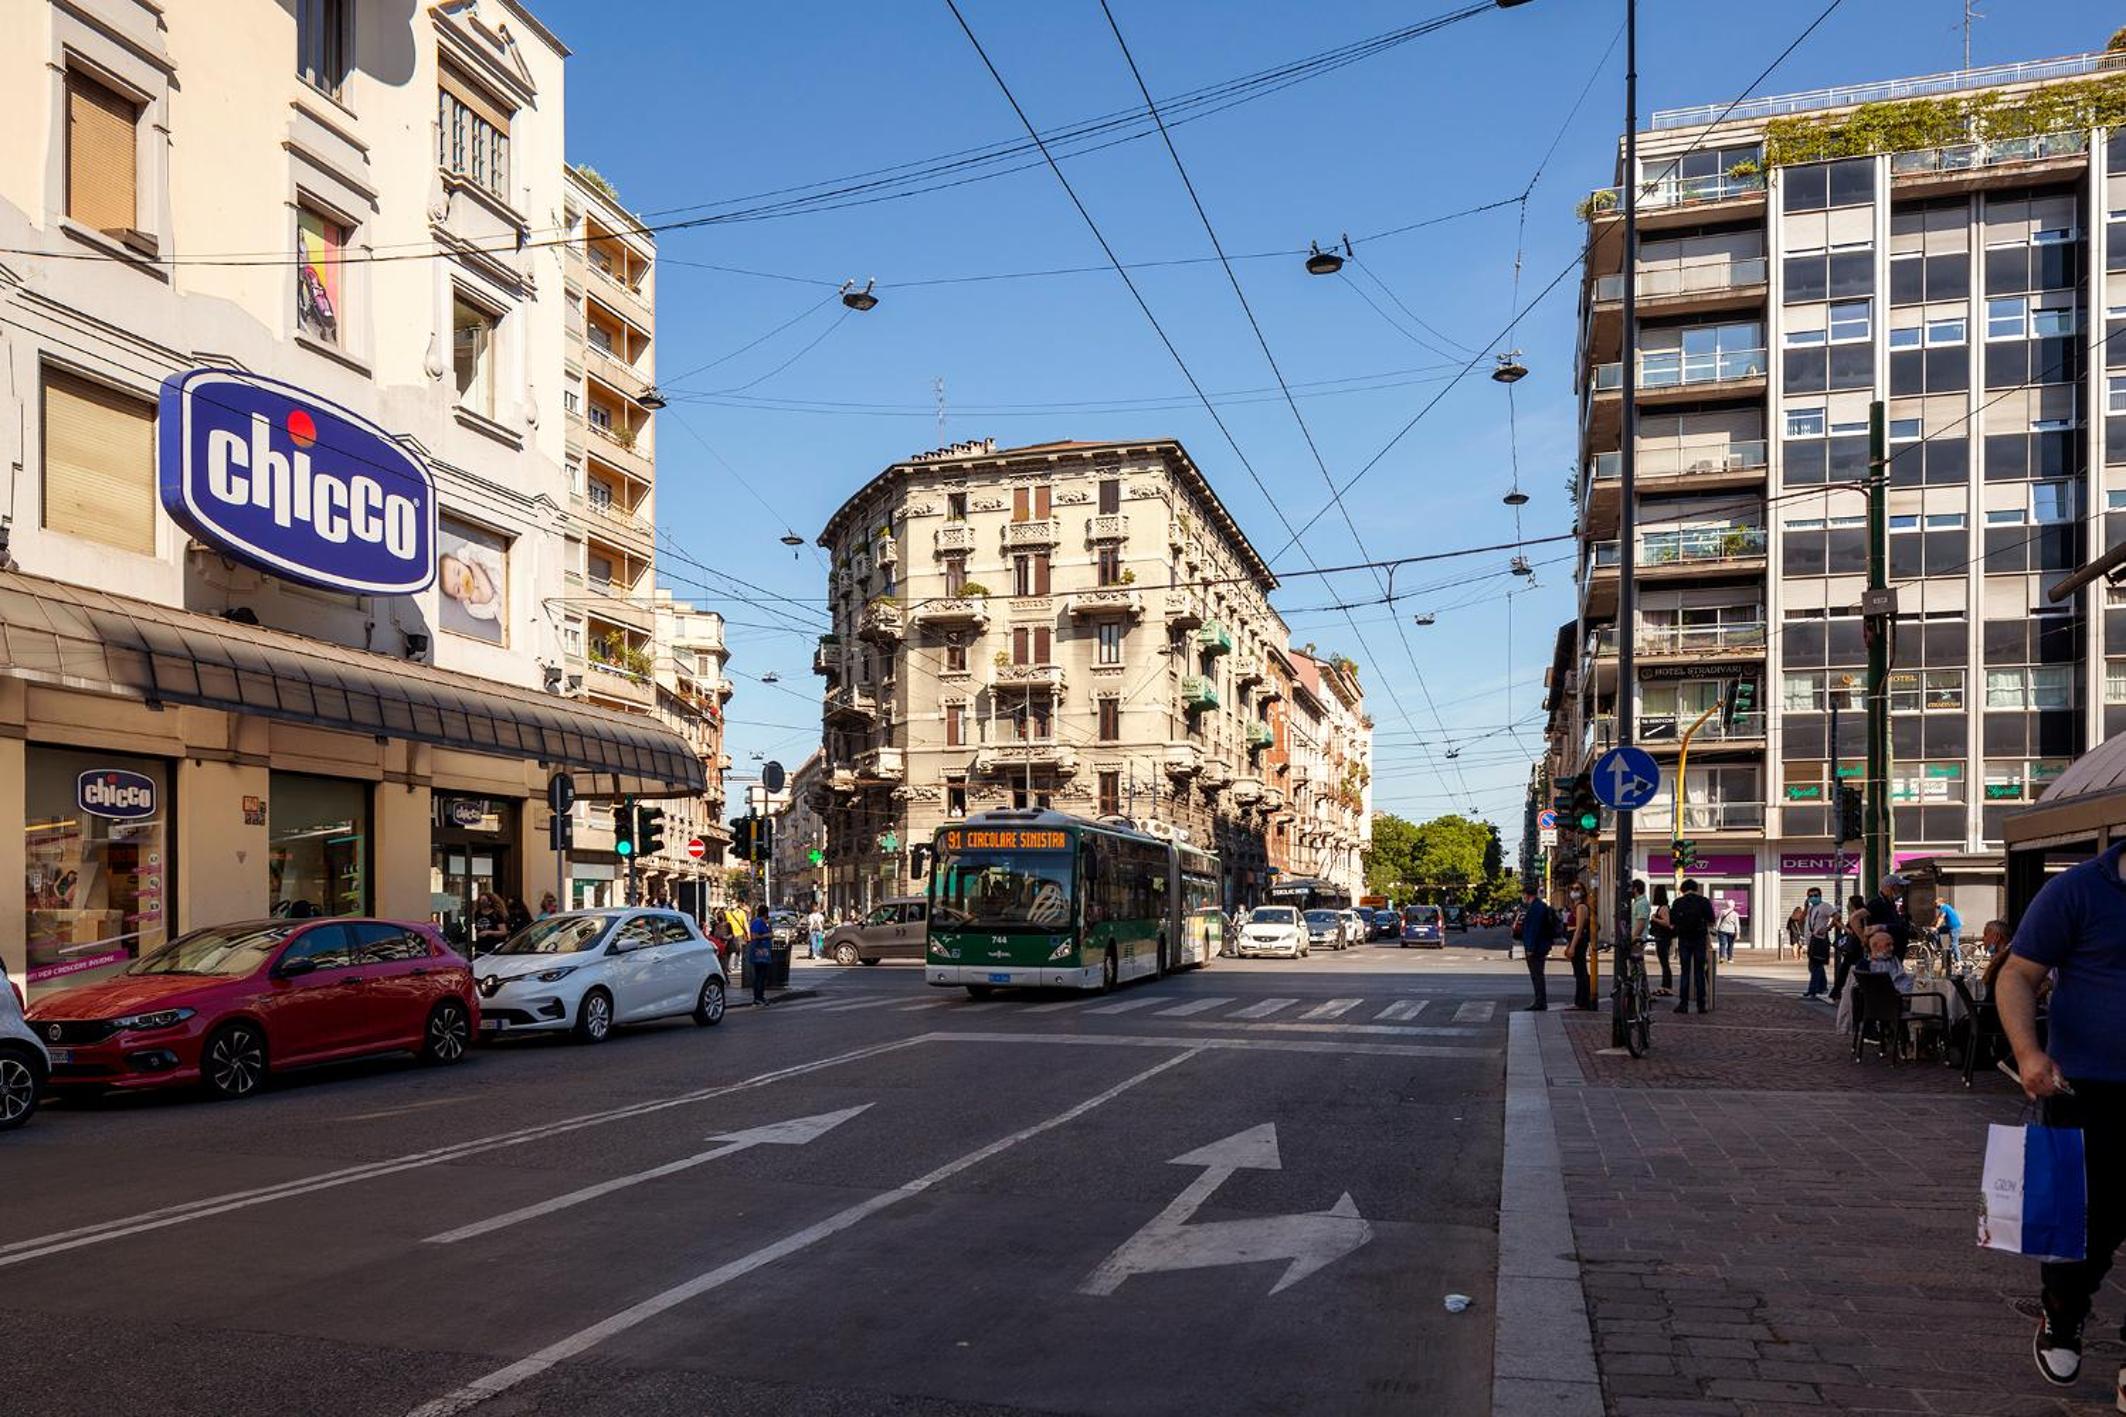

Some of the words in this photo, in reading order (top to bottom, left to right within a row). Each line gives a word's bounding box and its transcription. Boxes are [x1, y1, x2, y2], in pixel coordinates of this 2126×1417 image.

[207, 409, 417, 561] chicco
[1655, 668, 1685, 676] HOTEL
[1687, 665, 1742, 675] STRADIVARI
[84, 773, 151, 808] chicco
[947, 831, 961, 848] 91
[967, 832, 1018, 848] CIRCOLARE
[1020, 832, 1066, 849] SINISTRA
[1782, 858, 1857, 869] DENTX
